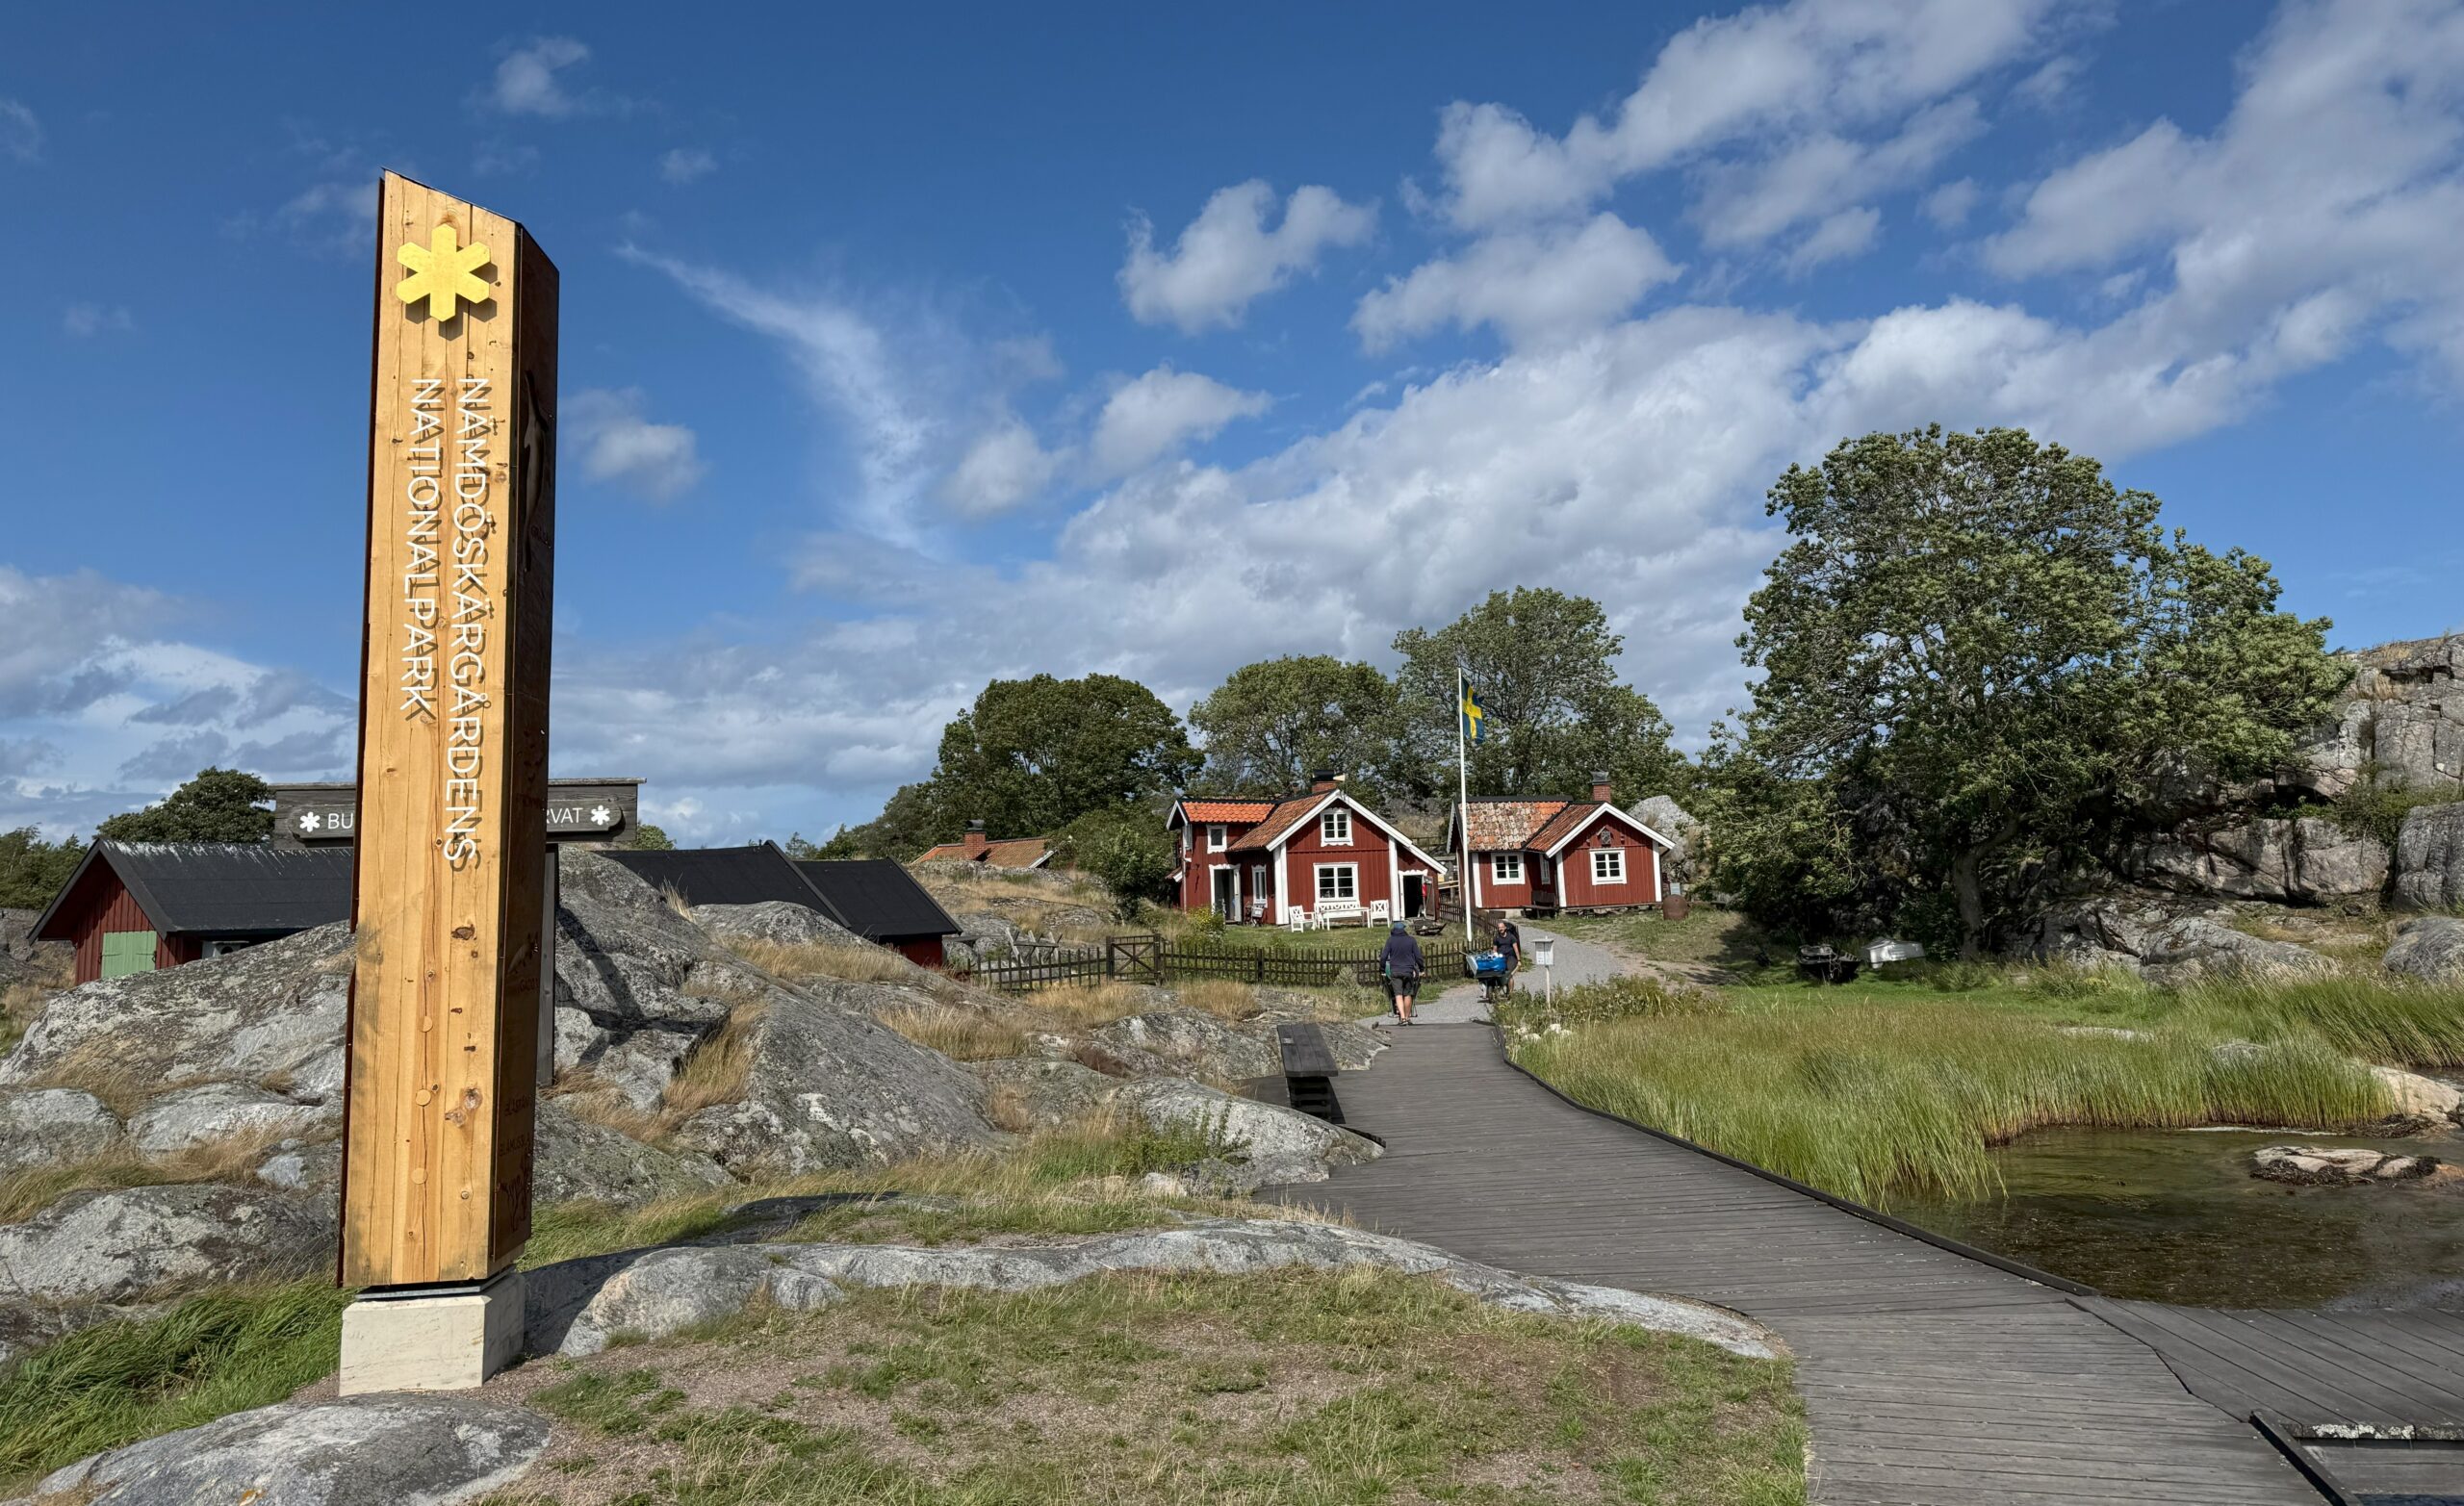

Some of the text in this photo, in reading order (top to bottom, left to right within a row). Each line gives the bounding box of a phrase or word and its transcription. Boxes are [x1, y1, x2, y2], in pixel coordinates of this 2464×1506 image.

[399, 378, 443, 710] NATIONALPARK
[443, 378, 495, 861] NÄMDÖSKÄRGÅRDENS
[328, 812, 354, 830] BU
